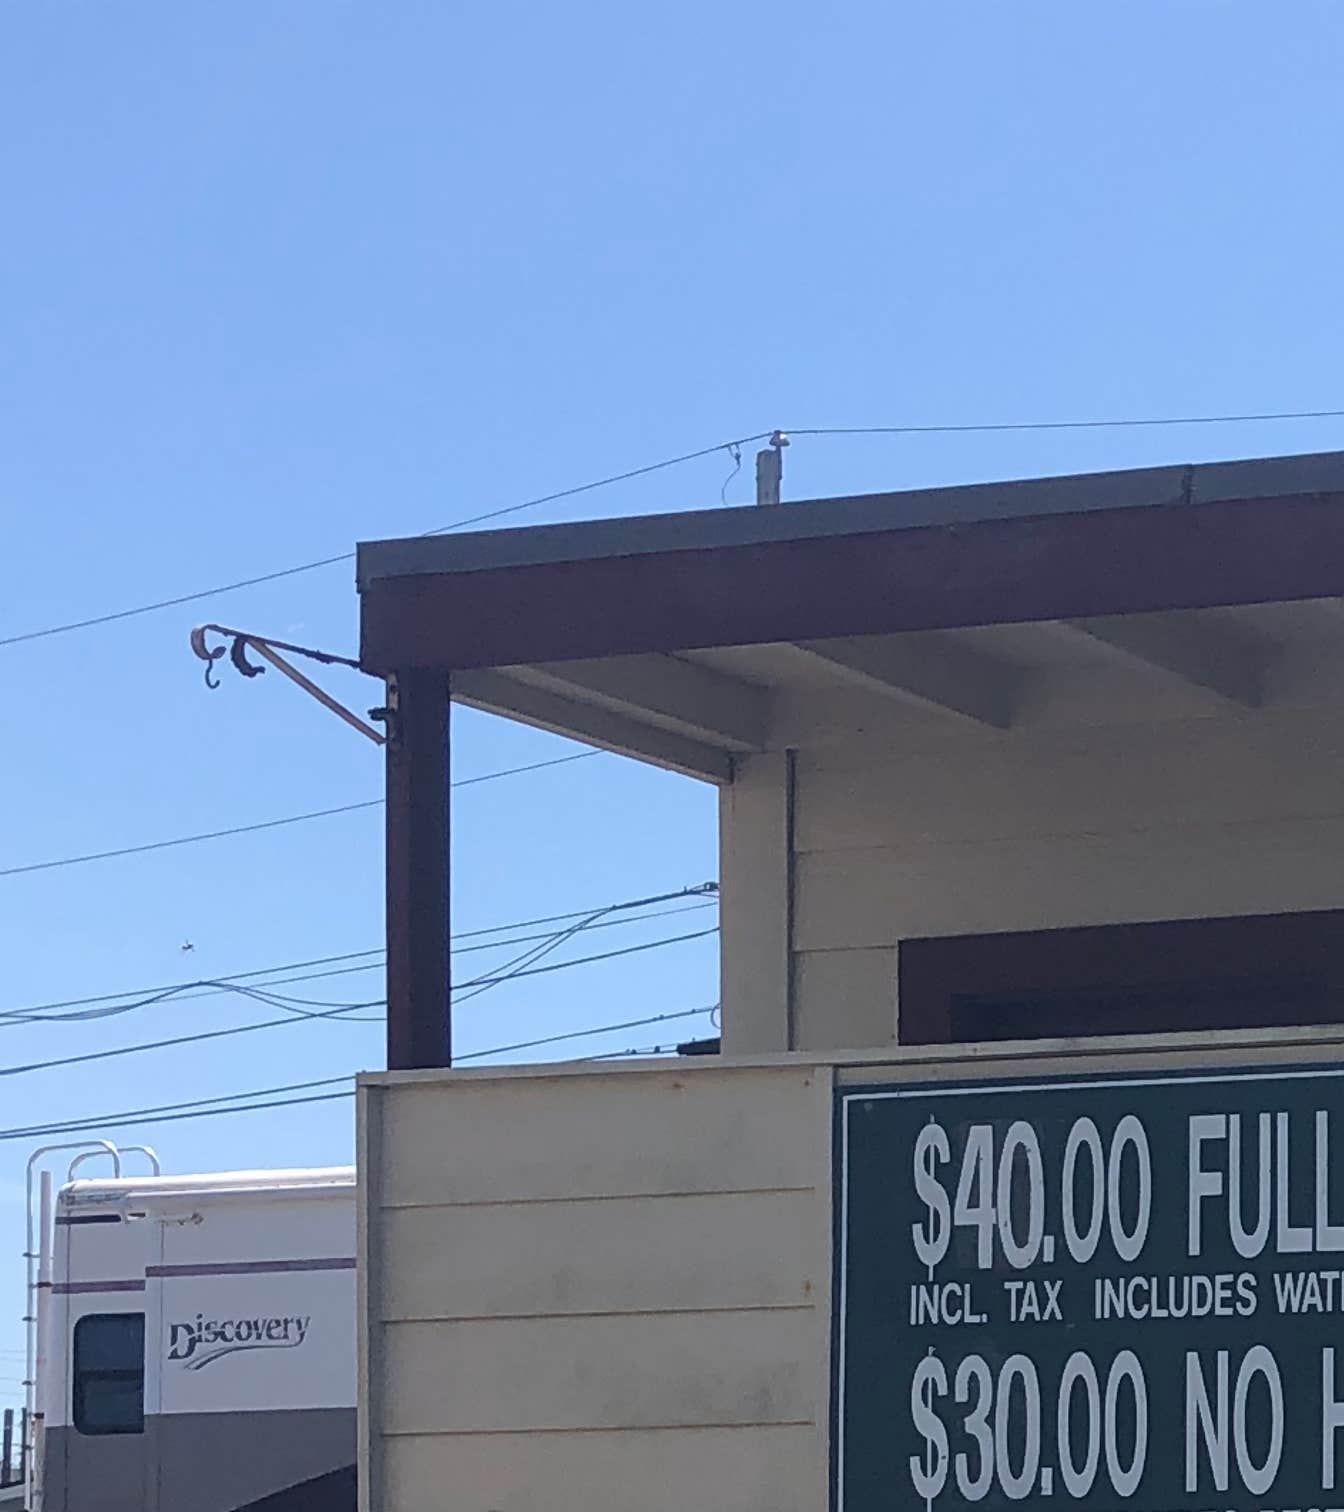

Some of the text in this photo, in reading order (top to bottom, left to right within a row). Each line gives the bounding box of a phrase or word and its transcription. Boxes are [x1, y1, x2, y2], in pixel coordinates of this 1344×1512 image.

[912, 1115, 1151, 1281] $40.00
[168, 1313, 310, 1359] Discovery
[911, 1283, 987, 1325] INCL.
[1004, 1281, 1062, 1321] TAX
[1096, 1273, 1256, 1319] INCLUDES
[1186, 1345, 1283, 1494] NO
